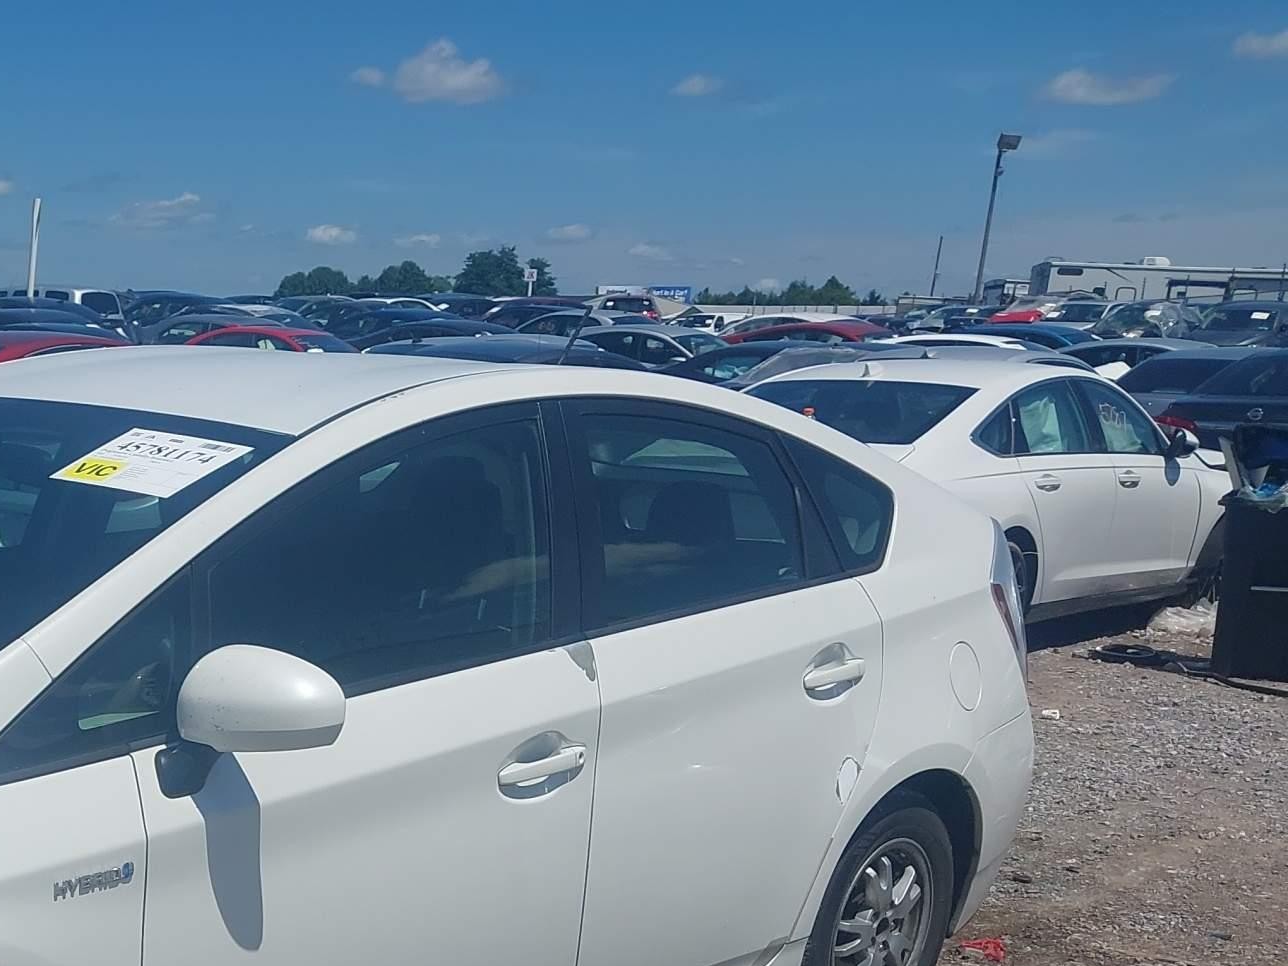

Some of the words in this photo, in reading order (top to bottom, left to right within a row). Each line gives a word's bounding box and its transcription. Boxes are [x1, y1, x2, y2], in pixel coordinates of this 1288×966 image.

[116, 441, 218, 465] 45781174
[74, 462, 118, 477] VIC
[52, 867, 122, 902] HYBRID
